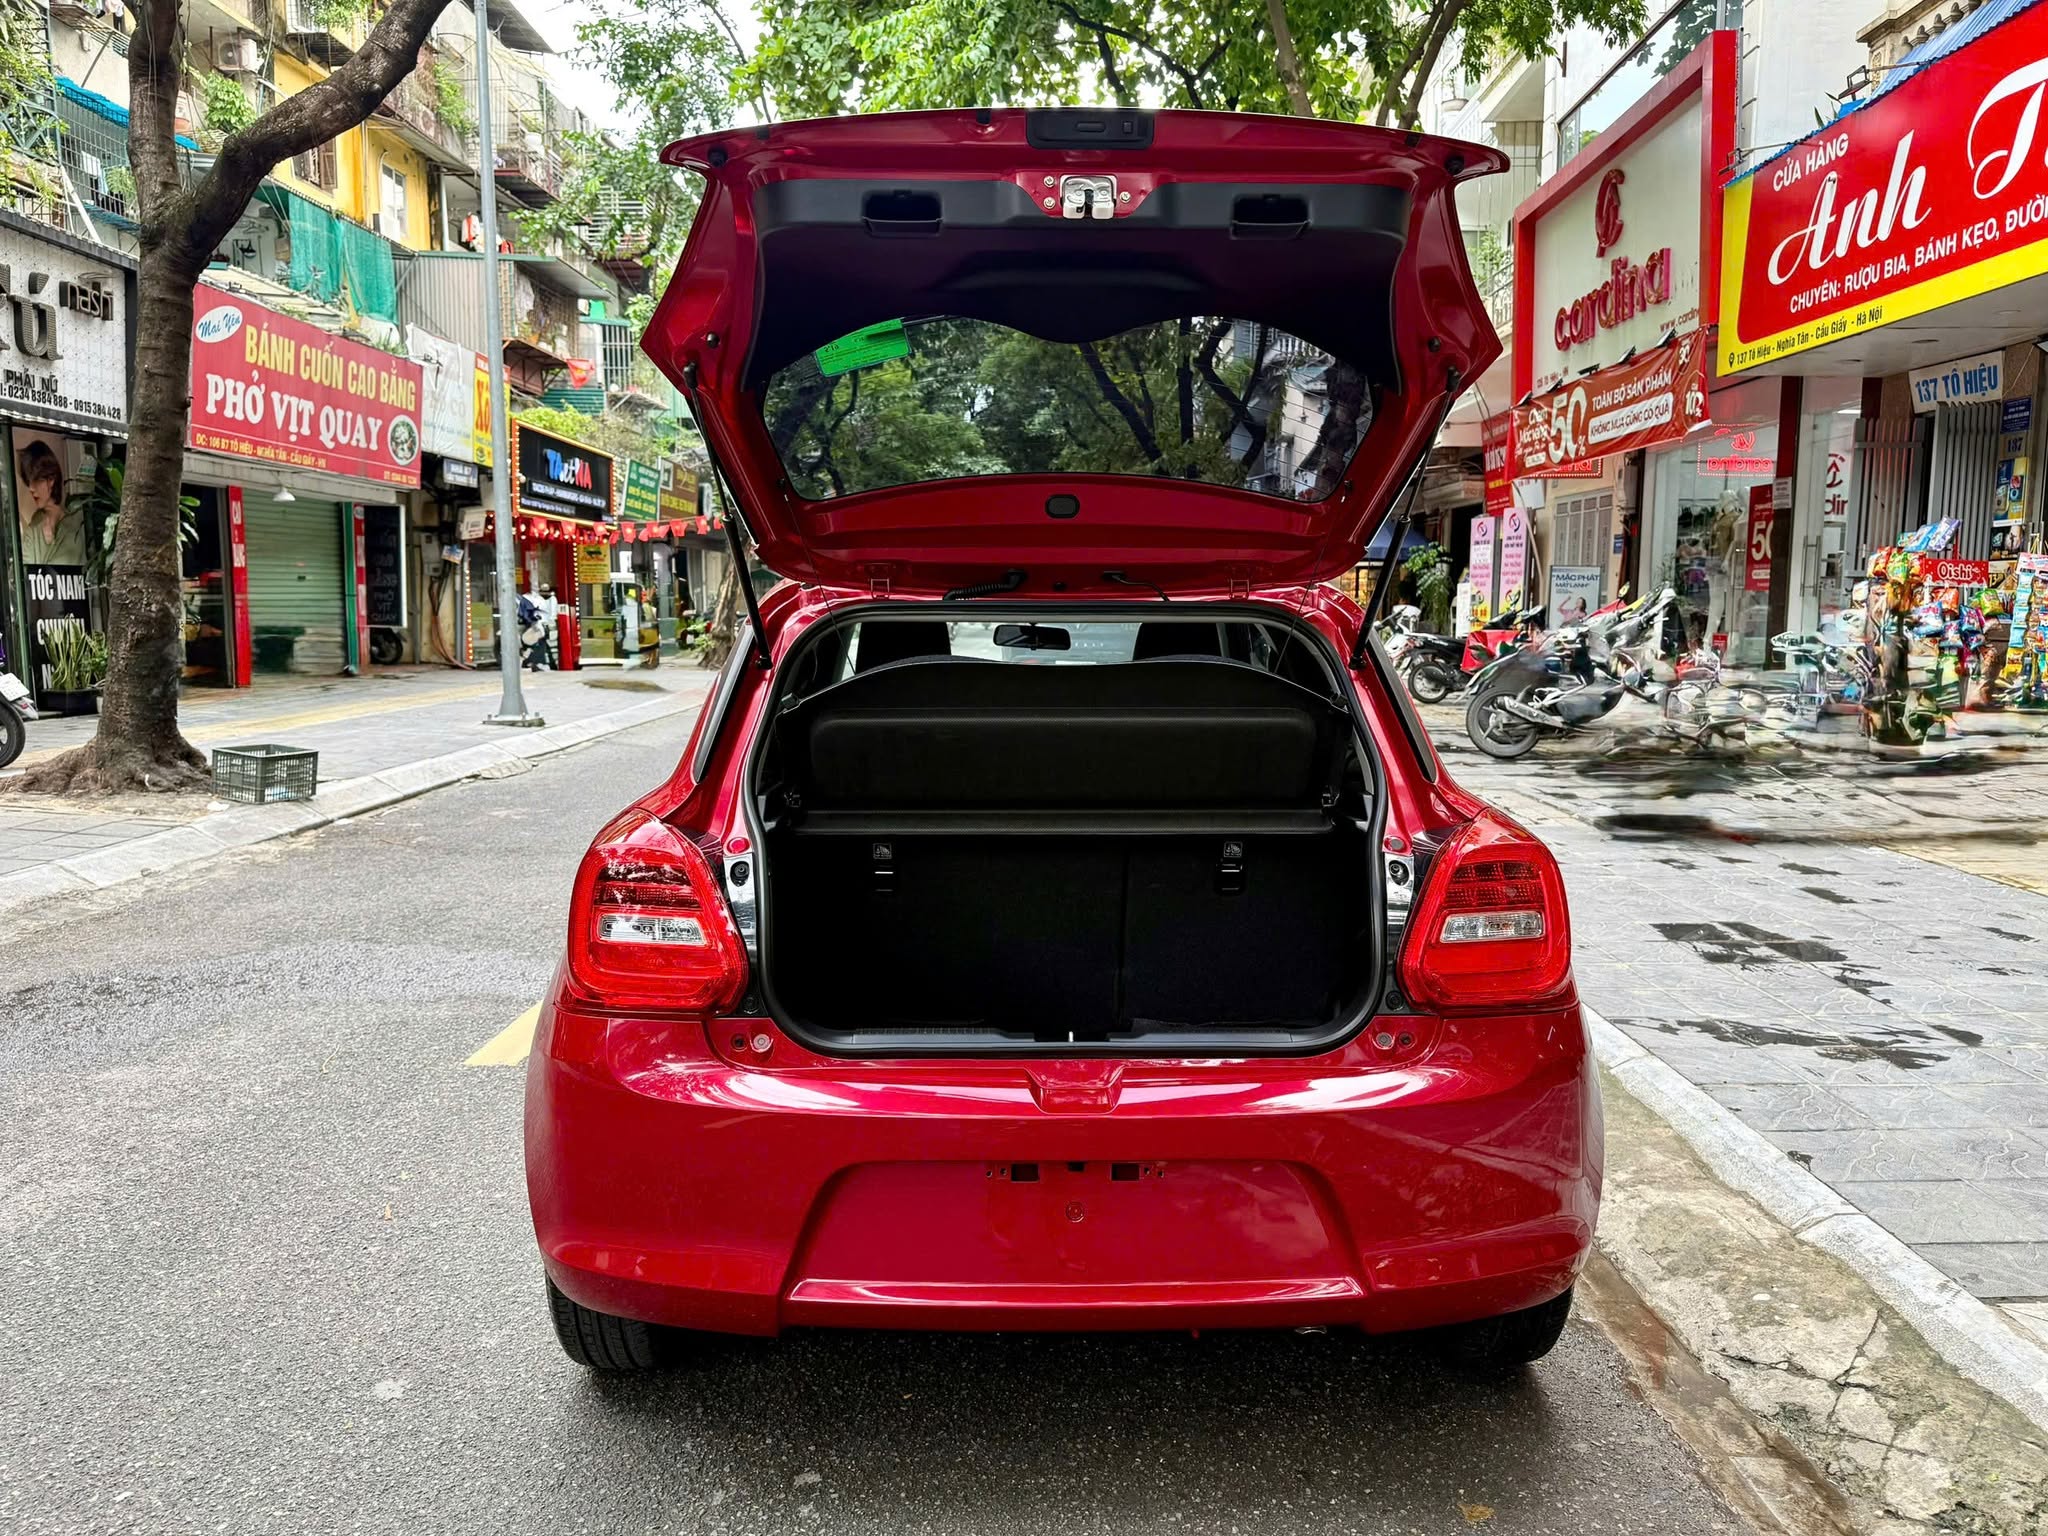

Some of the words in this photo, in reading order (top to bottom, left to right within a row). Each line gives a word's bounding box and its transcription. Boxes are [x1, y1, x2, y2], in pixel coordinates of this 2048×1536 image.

[1767, 129, 1932, 286] Anh
[1967, 56, 2048, 200] T
[1773, 157, 1801, 192] CỬA
[1805, 133, 1849, 179] HÀNG
[1789, 279, 1841, 314] CHUYÊN:
[1844, 262, 1880, 293] RƯỢU
[1884, 255, 1910, 280] BIA,
[1914, 236, 1957, 268] BÁNH
[1961, 217, 1999, 251] KẸO,
[198, 315, 221, 339] Mai
[223, 311, 241, 335] Yên
[1555, 247, 1671, 352] cardina
[1737, 351, 1747, 366] 137
[1756, 345, 1771, 360] Hiệu
[1857, 312, 1867, 327] Hà
[1869, 305, 1883, 324] Nội
[245, 322, 295, 376] BÁNH
[300, 341, 344, 391] CUỐN
[347, 361, 377, 401] CAO
[379, 360, 416, 412] BẰNG
[1592, 389, 1613, 412] TOÀN
[1614, 384, 1625, 406] BỘ
[1626, 377, 1644, 400] SẢN
[1915, 377, 1938, 403] 137
[1942, 368, 1960, 398] TÔ
[1963, 363, 1998, 396] HIỆU
[8, 385, 30, 401] 0234
[31, 390, 52, 406] 8384
[53, 394, 68, 409] 888
[74, 399, 92, 414] 0915
[92, 402, 106, 417] 384
[107, 406, 121, 420] 428
[205, 369, 265, 424] PHỞ
[271, 391, 315, 442] VỊT
[319, 405, 383, 450] QUAY
[29, 568, 54, 600] TÓC
[56, 574, 86, 600] NAM
[1937, 561, 1973, 580] Oishi
